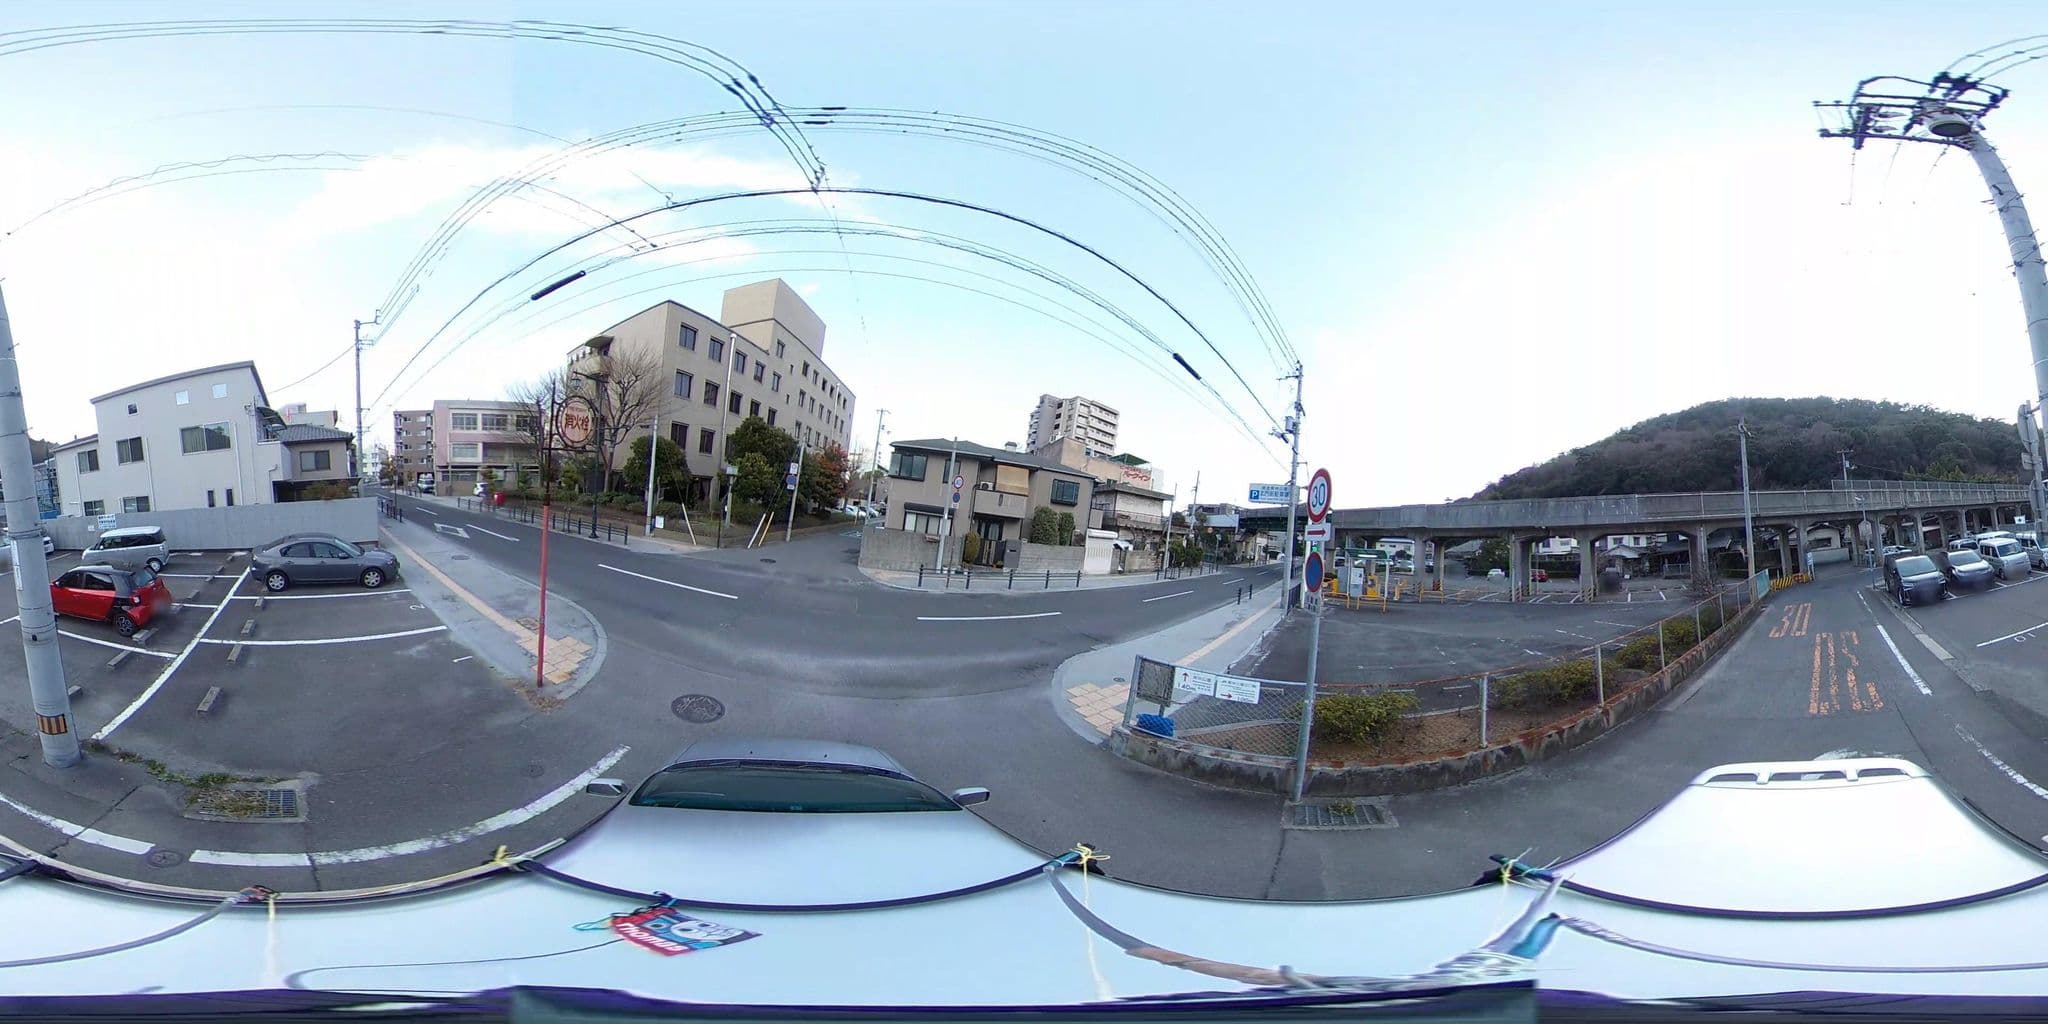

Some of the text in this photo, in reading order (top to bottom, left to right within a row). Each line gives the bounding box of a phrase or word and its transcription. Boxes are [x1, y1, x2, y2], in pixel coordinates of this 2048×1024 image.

[564, 413, 590, 434] 消火栓
[1311, 483, 1326, 508] 30
[1768, 602, 1812, 638] 30
[614, 922, 690, 952] Thomas
